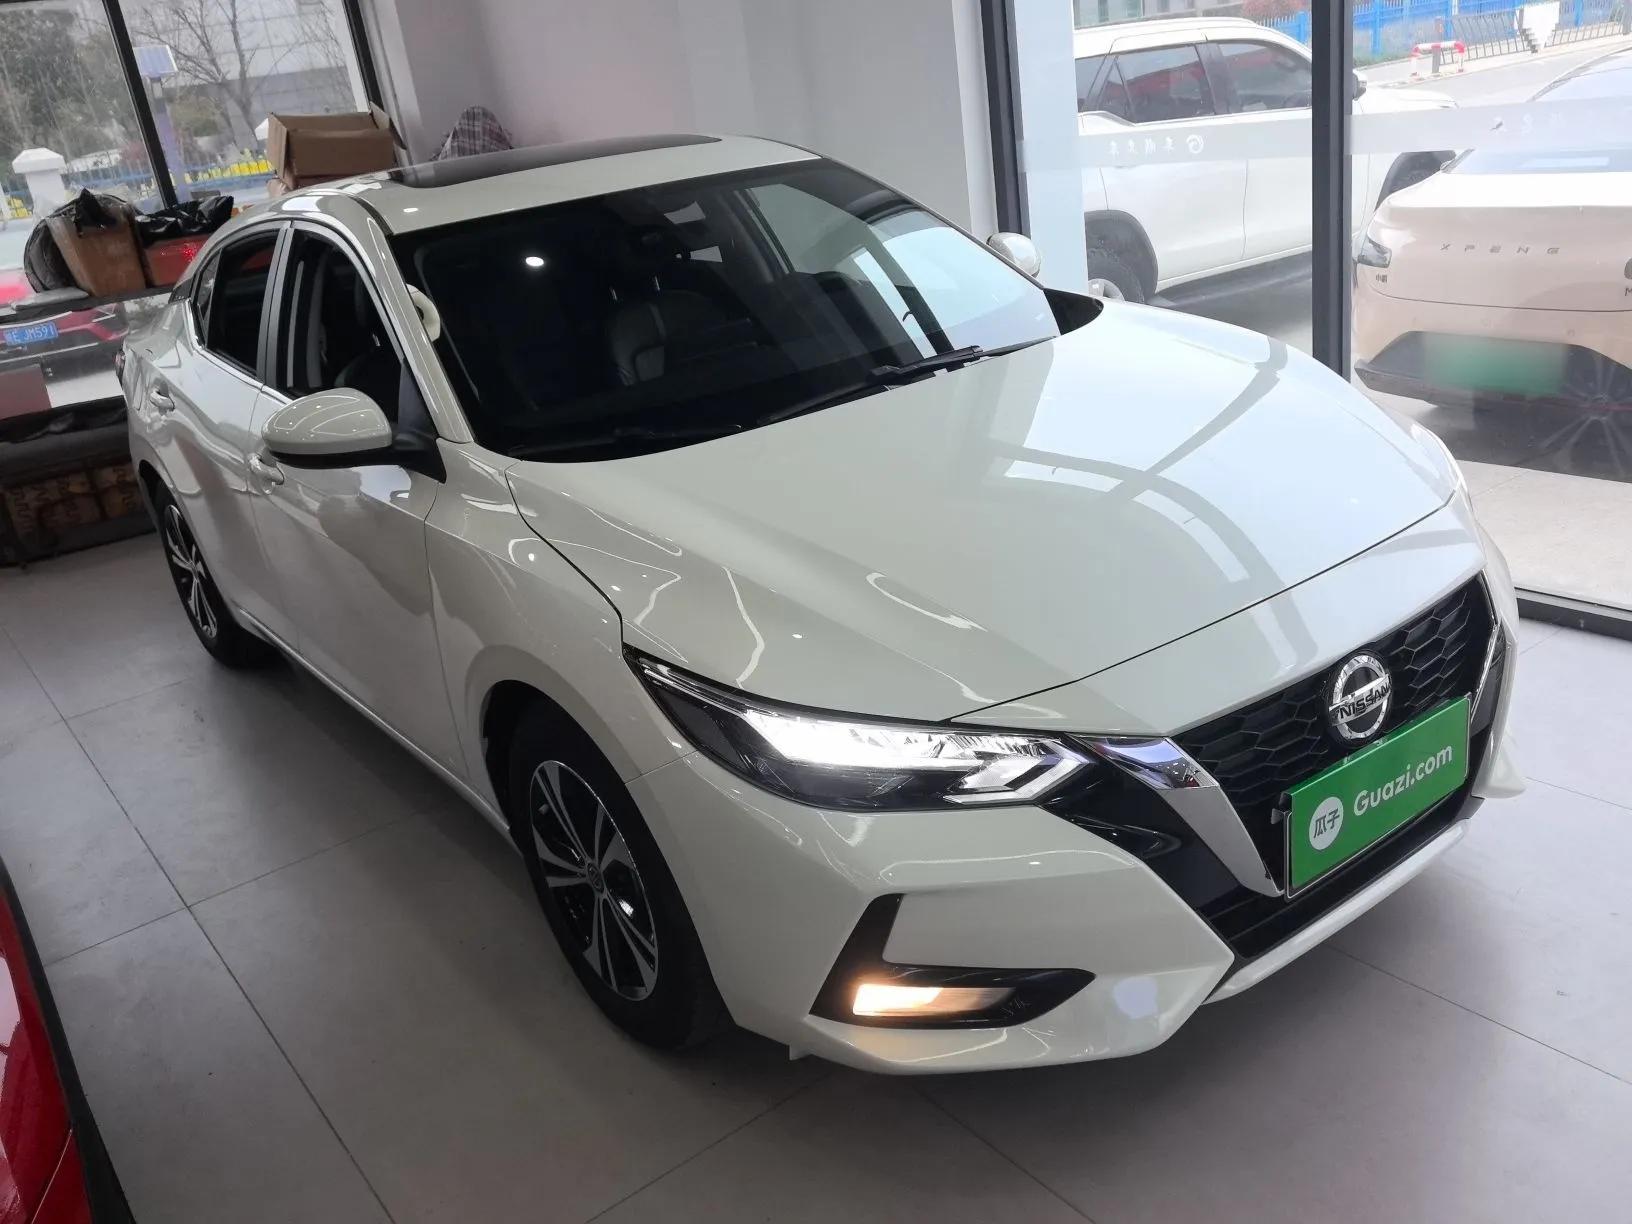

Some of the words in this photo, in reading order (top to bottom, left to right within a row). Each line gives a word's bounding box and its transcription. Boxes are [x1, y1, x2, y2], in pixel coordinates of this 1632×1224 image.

[1440, 243, 1560, 255] XPENG
[1339, 681, 1391, 719] NISSAN
[1313, 807, 1341, 839] 瓜子
[1353, 745, 1453, 817] Guazi.com
